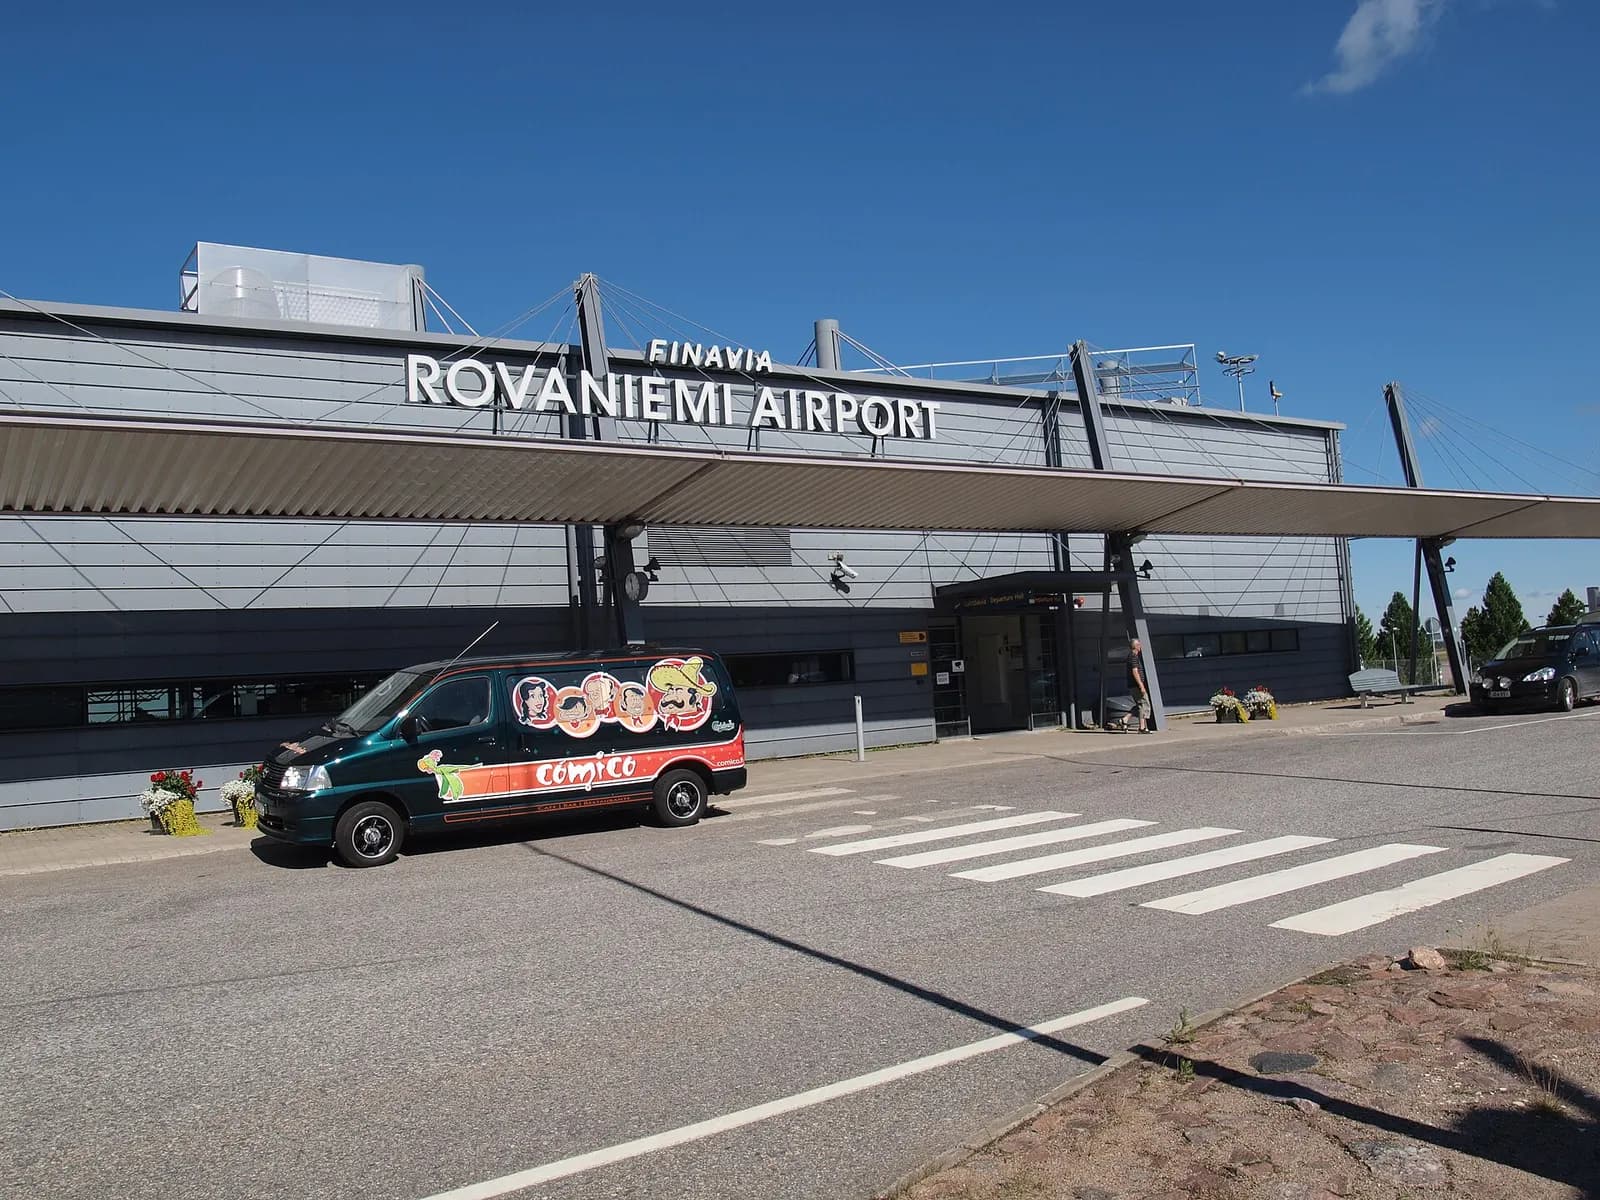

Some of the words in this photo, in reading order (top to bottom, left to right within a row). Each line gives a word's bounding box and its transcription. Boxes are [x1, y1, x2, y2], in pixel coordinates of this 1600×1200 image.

[646, 338, 774, 373] FINAVIA
[406, 353, 734, 426] ROVANIEMI
[751, 386, 942, 440] AIRPORT
